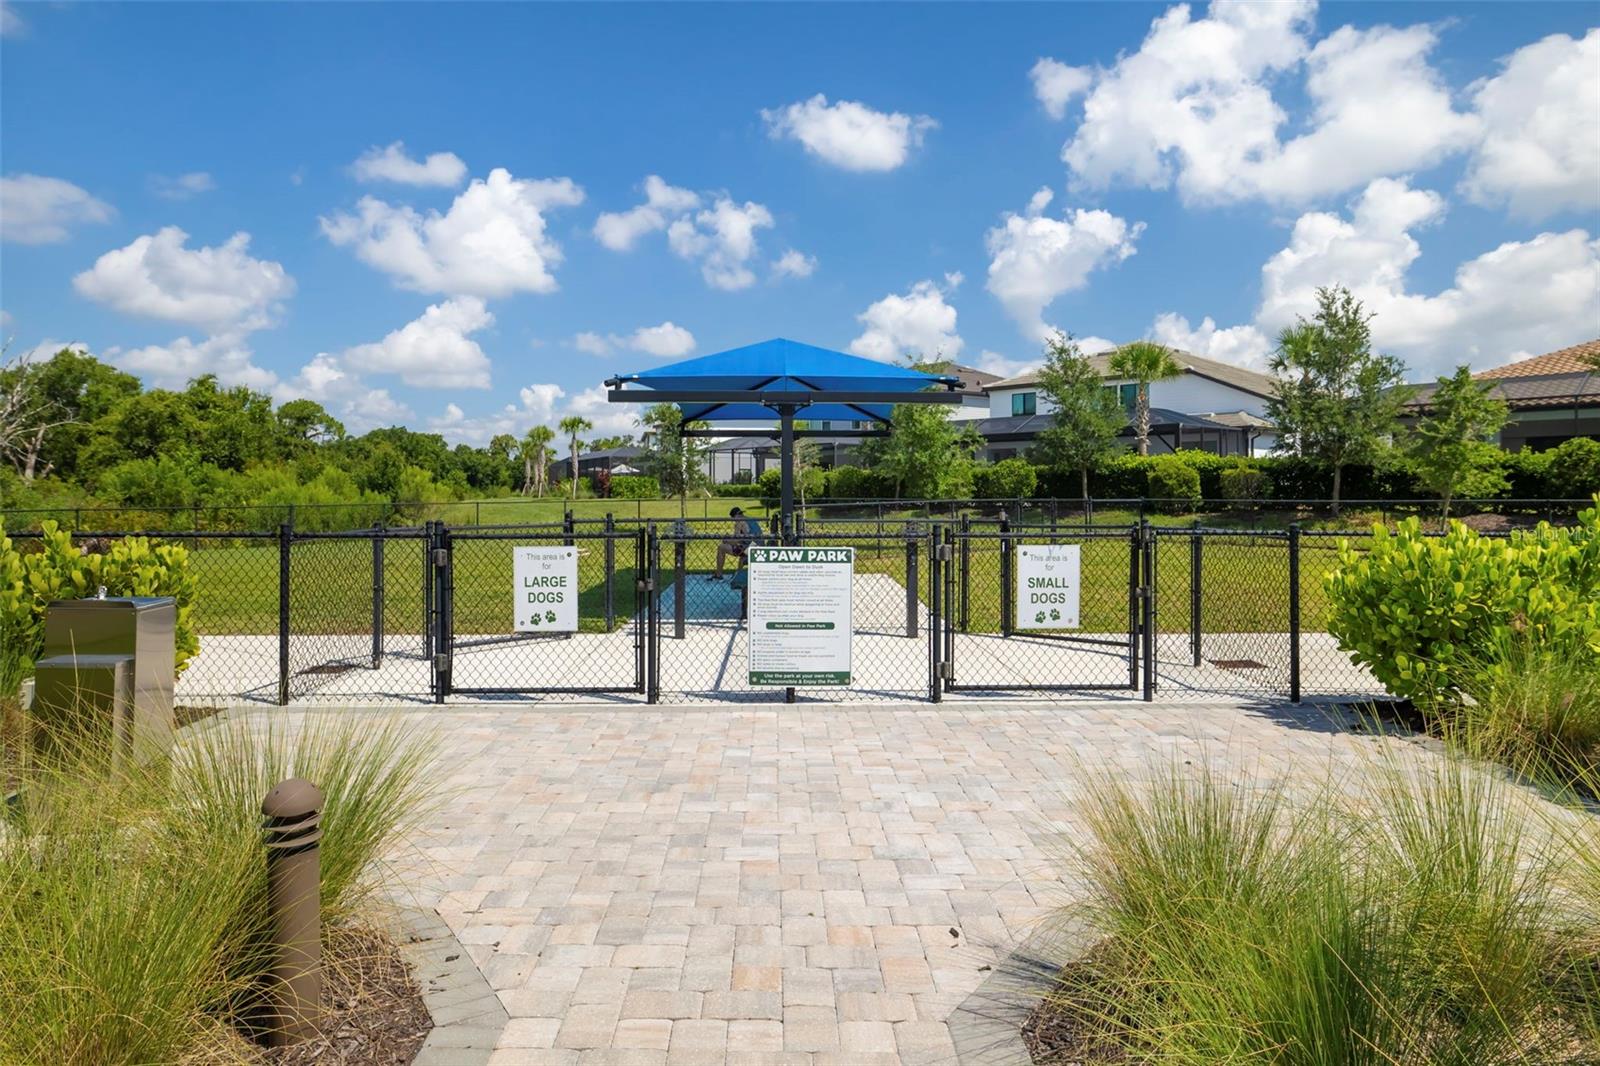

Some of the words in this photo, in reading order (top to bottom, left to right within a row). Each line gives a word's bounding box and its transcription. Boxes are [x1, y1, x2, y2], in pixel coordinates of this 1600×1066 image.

[769, 550, 803, 561] PAW
[808, 550, 847, 561] PARK
[542, 562, 552, 570] for
[1045, 563, 1054, 571] for
[524, 576, 567, 588] LARGE
[1027, 577, 1069, 588] SMALL
[528, 592, 564, 603] DOGS
[1031, 592, 1066, 604] DOGS
